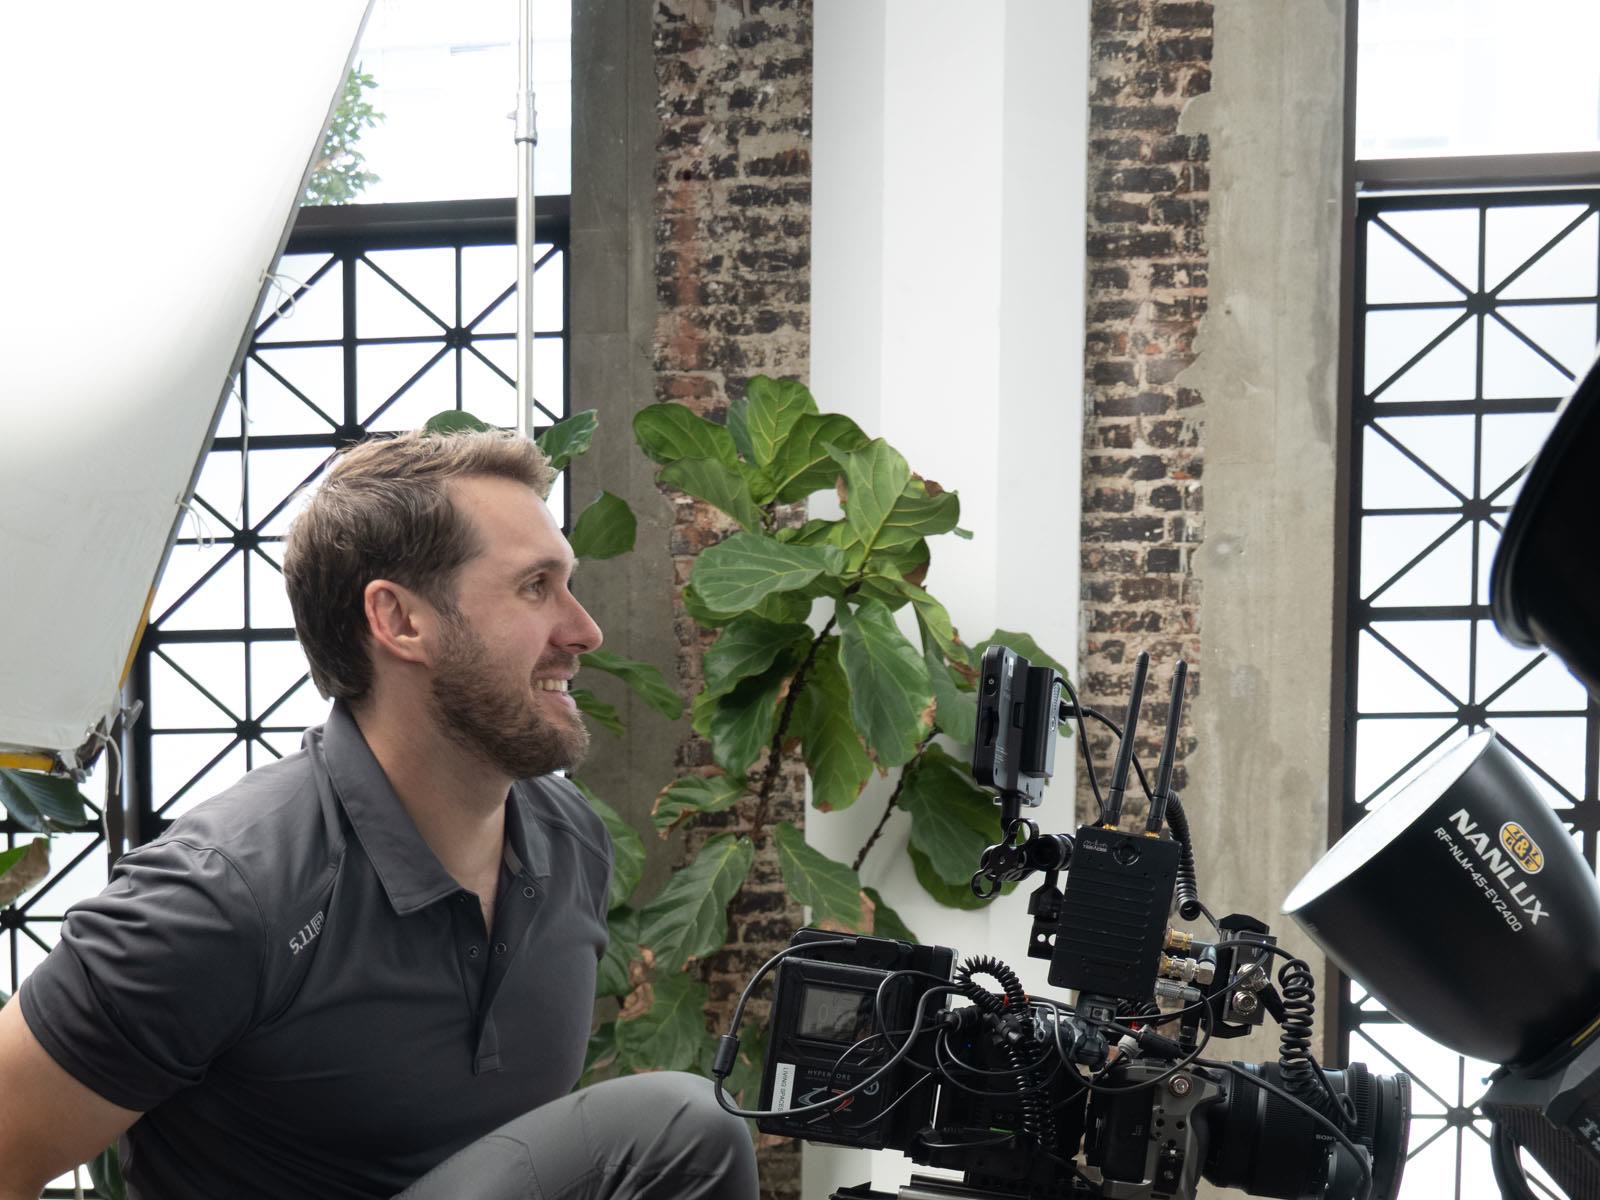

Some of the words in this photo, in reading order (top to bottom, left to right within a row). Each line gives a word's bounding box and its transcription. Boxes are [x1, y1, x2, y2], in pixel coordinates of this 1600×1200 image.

[1434, 827, 1523, 932] RF-NLM-45-EV2400
[1448, 808, 1549, 925] NANLUX
[289, 924, 317, 955] 5.11
[780, 1067, 789, 1088] LIVING
[807, 1069, 851, 1081] HYPERORE
[777, 1089, 787, 1112] SPACES
